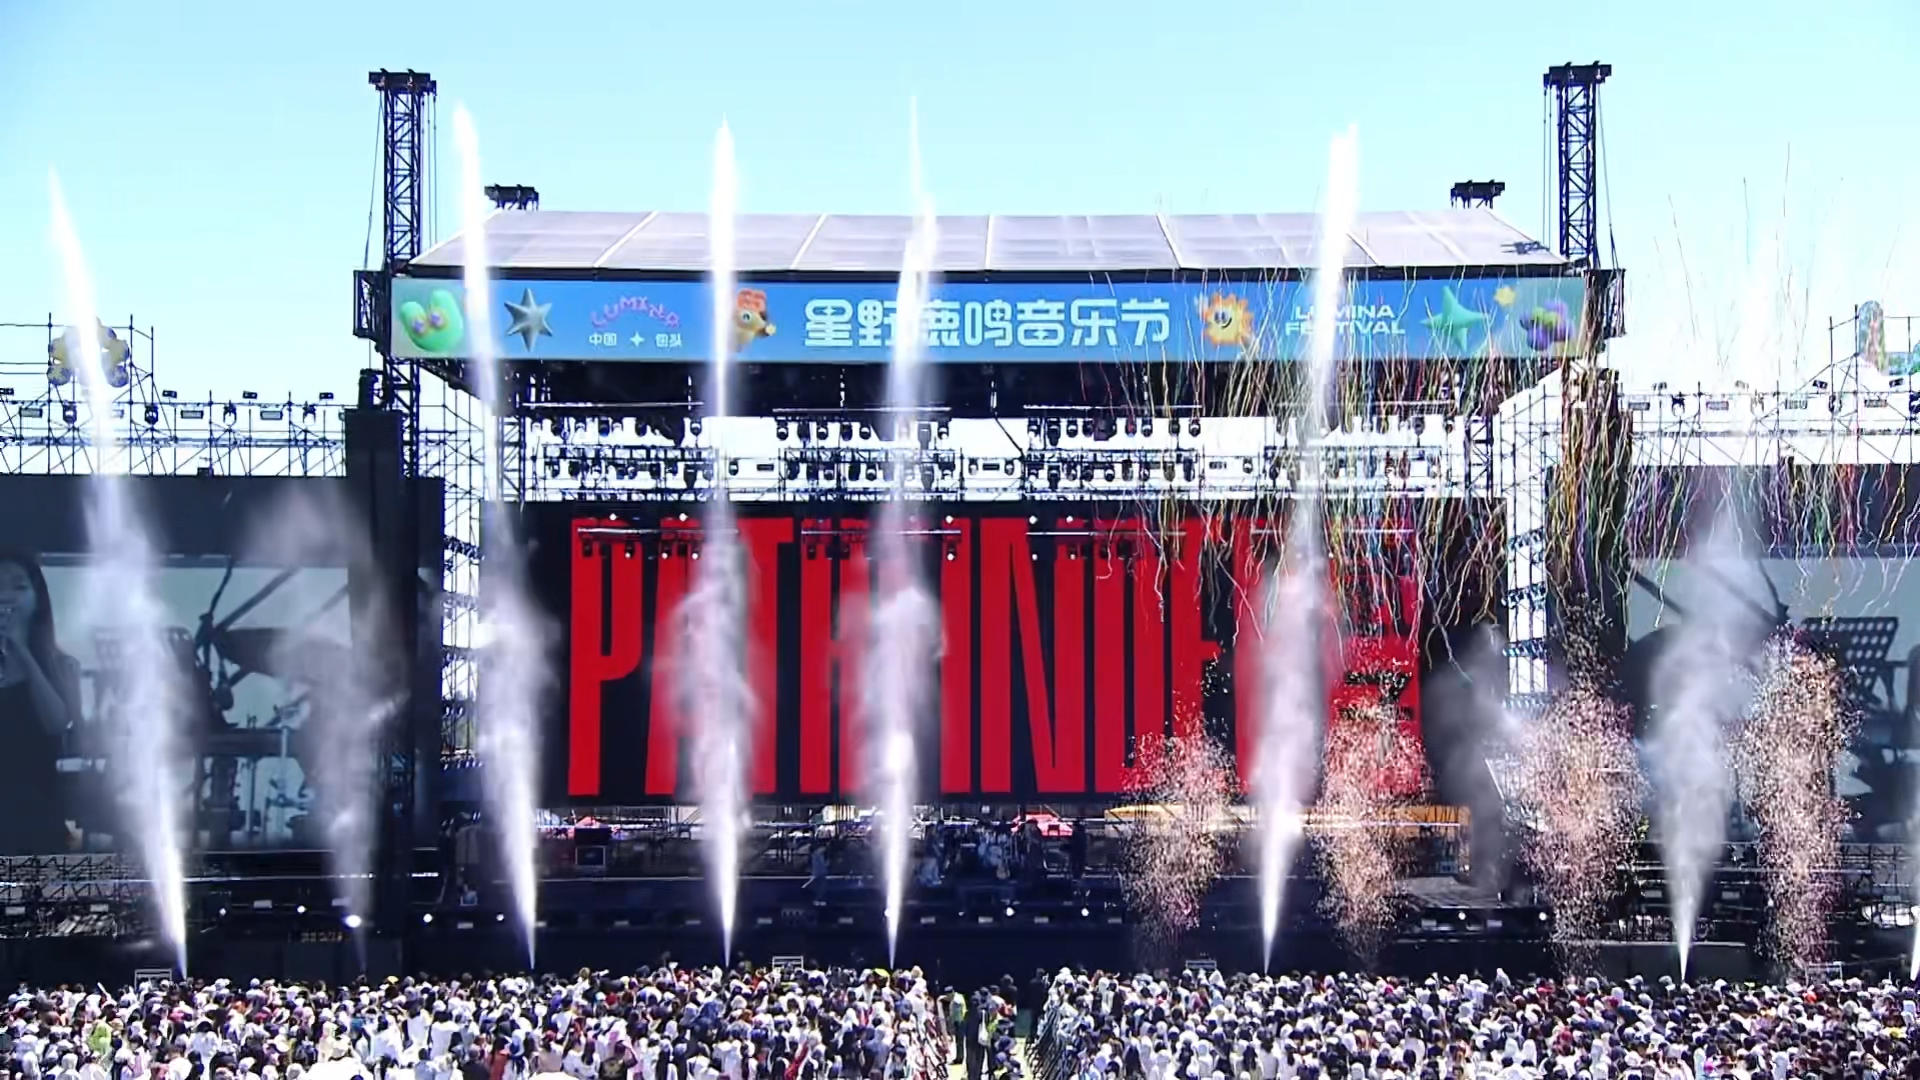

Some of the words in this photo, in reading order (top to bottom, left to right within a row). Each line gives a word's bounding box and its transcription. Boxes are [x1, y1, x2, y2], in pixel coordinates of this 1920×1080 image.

[1295, 304, 1396, 319] LMINA
[1285, 320, 1406, 336] FETIVAL
[589, 332, 617, 347] 中国
